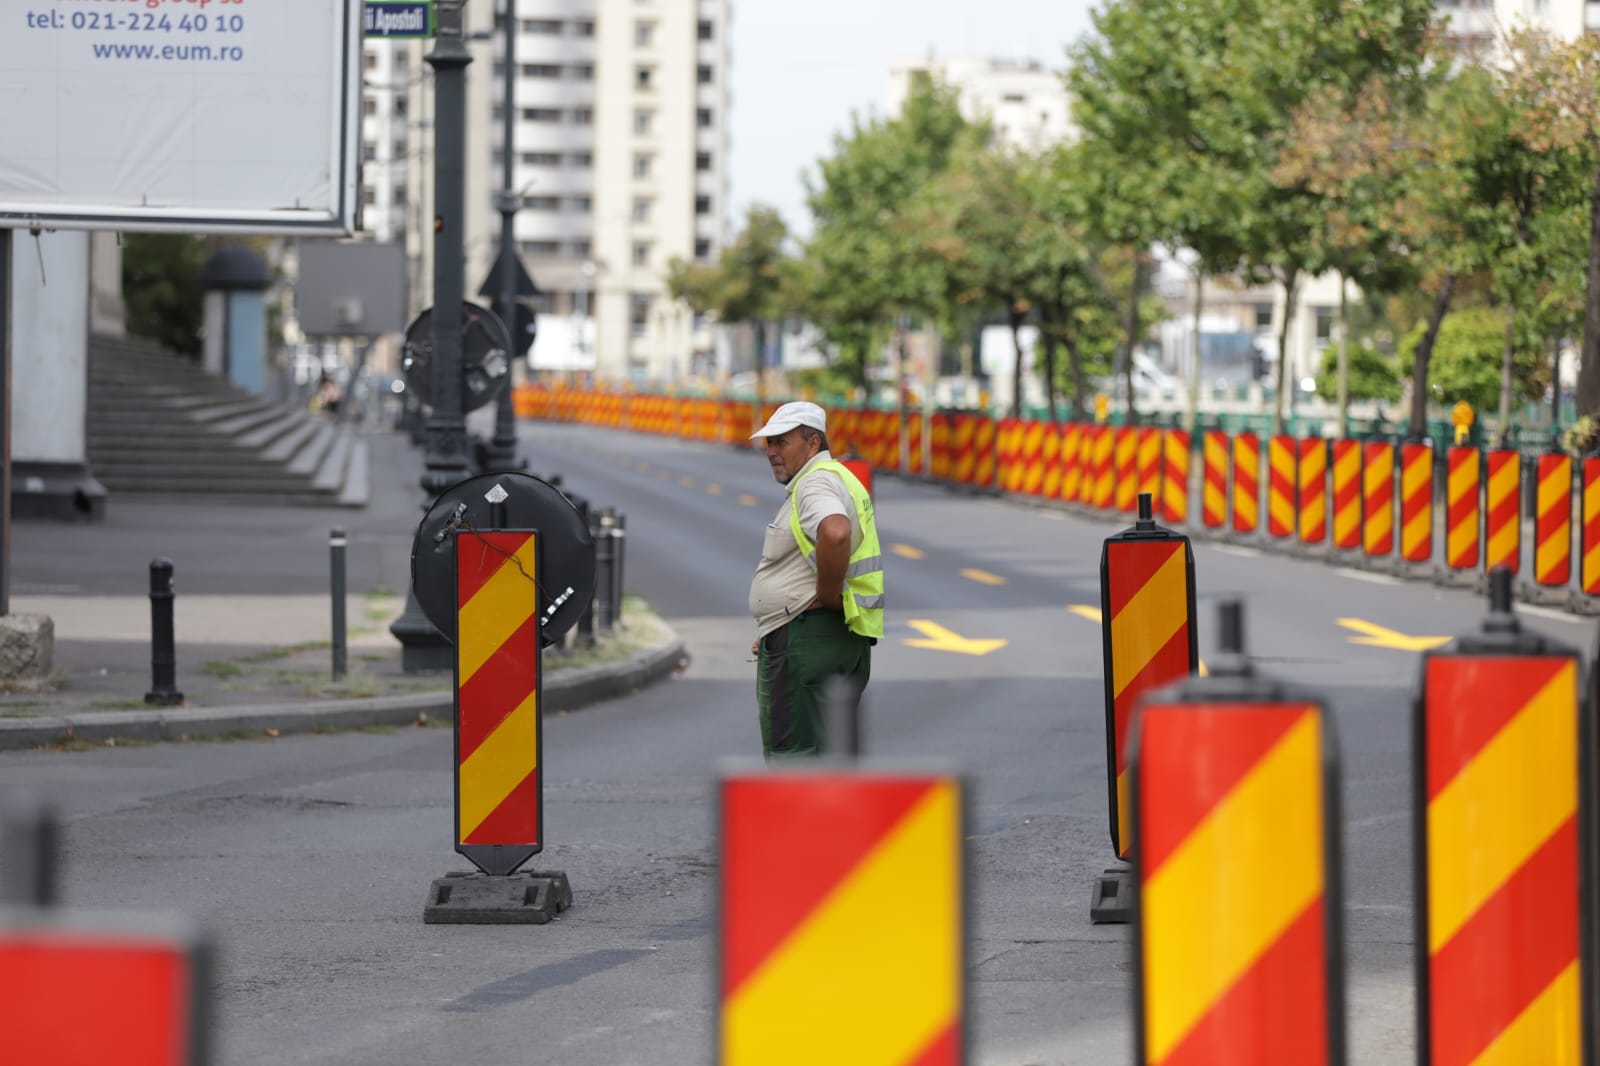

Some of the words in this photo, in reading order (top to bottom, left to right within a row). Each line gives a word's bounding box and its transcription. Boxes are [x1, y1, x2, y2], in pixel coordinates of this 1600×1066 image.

[26, 9, 65, 29] tel:
[71, 11, 172, 32] 021-224
[178, 13, 208, 33] 40
[215, 14, 244, 33] 10
[375, 7, 424, 35] Apostoli
[92, 43, 244, 61] www.eum.ro
